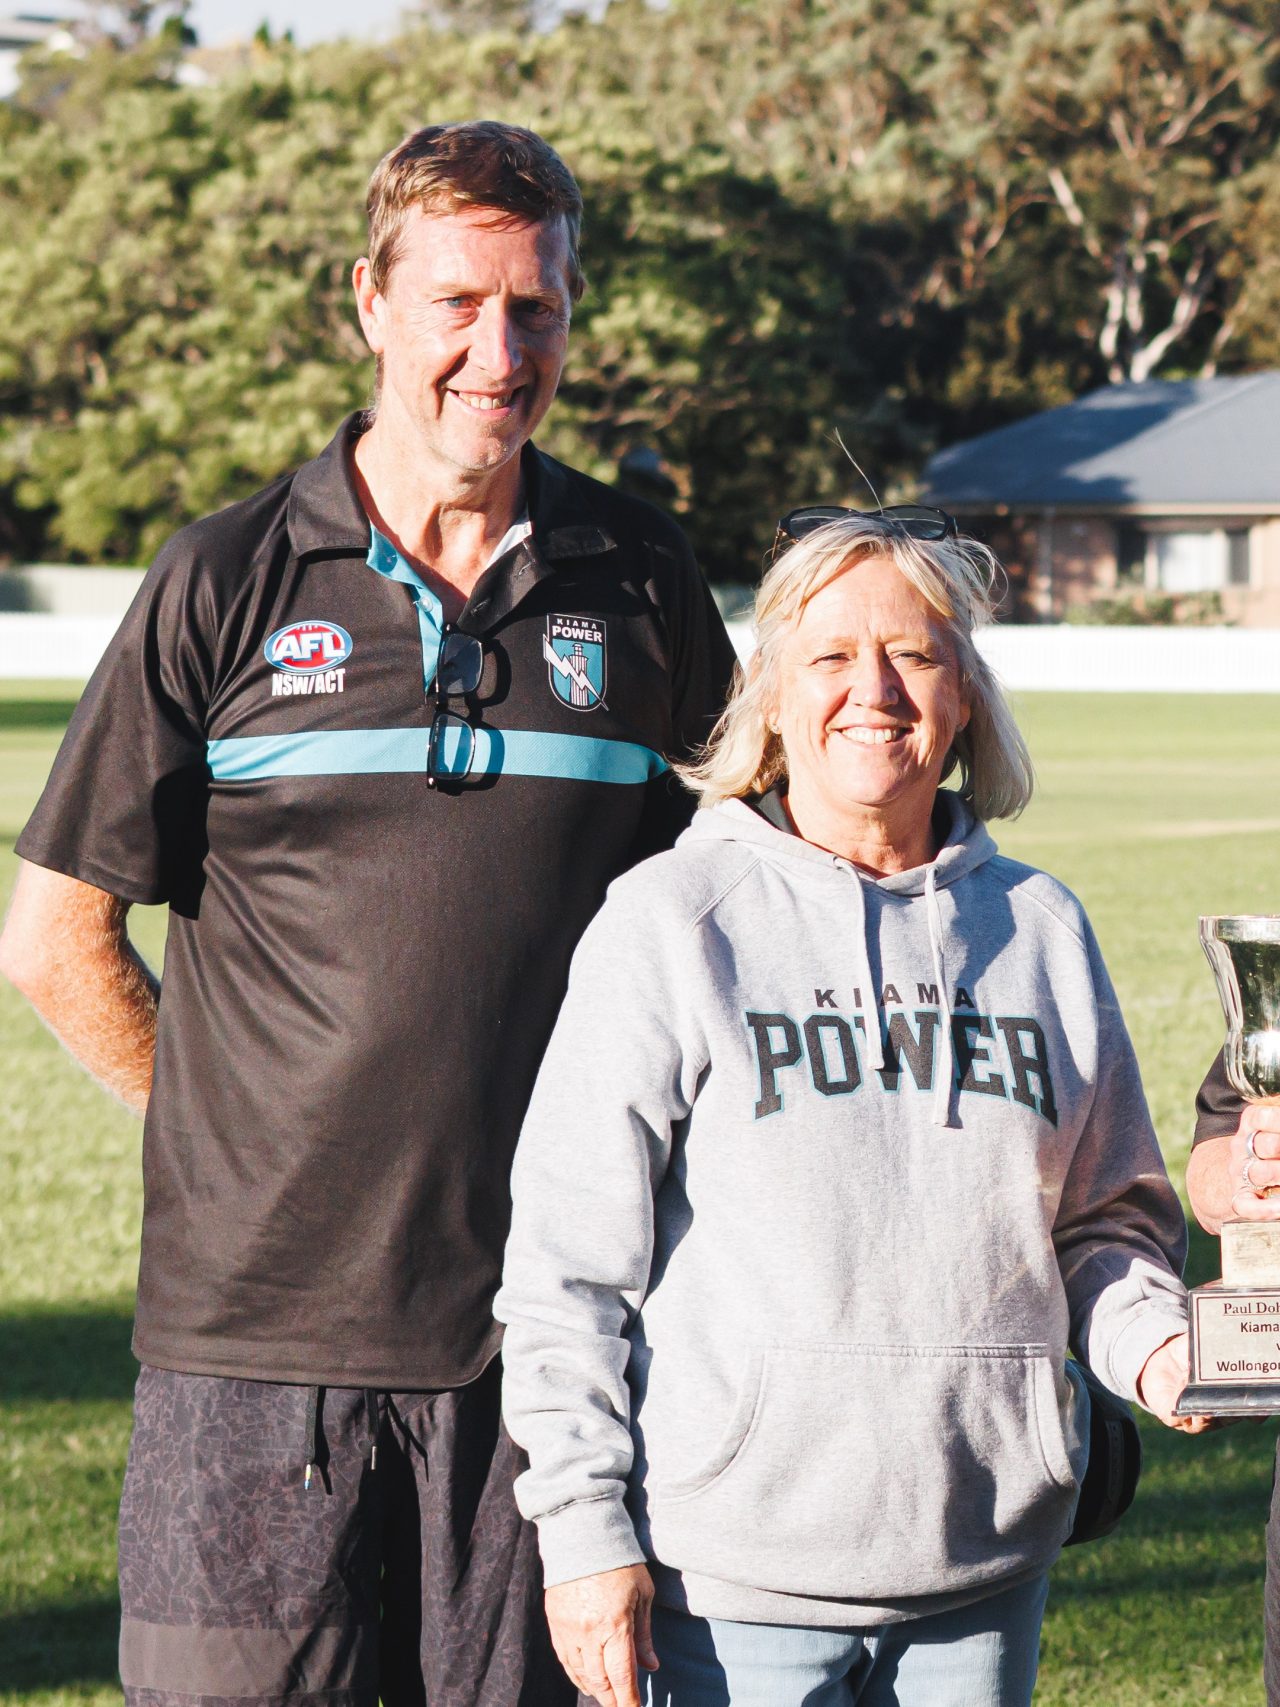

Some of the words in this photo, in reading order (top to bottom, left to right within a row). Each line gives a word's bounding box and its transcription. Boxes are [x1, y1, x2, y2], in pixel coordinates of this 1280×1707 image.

[552, 625, 603, 643] POWER
[557, 618, 597, 630] KIAMA
[272, 631, 346, 662] AFL
[272, 668, 346, 696] NSW/ACT
[814, 983, 976, 1009] KIAMA
[744, 1008, 1059, 1131] POWER
[1223, 1303, 1252, 1314] Paul
[1240, 1321, 1280, 1333] Kiama
